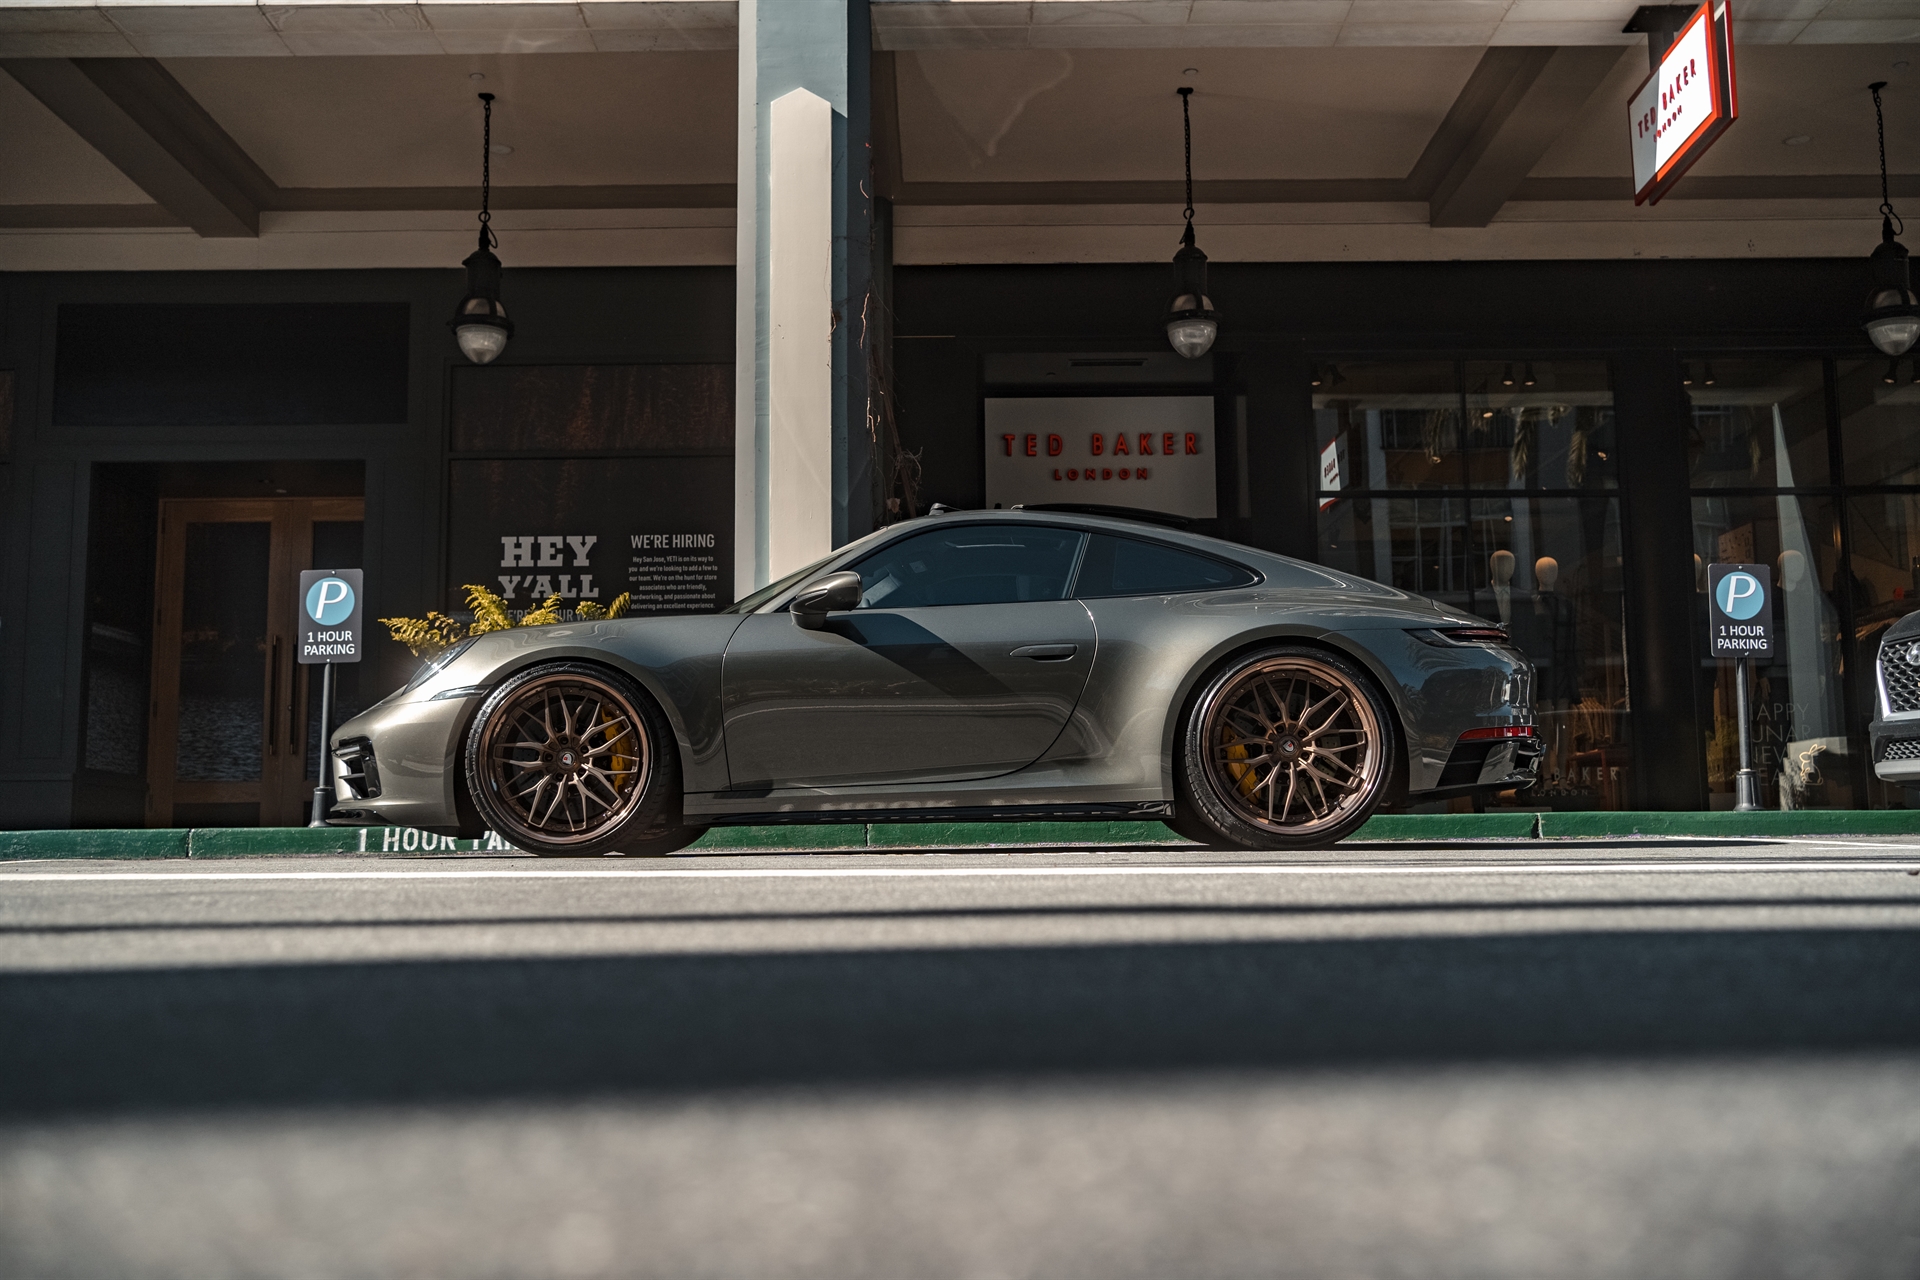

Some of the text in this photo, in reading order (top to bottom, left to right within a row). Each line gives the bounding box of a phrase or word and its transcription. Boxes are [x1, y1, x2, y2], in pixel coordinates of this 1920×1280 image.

[1638, 58, 1696, 138] TED BAKER
[1653, 104, 1682, 143] LONDON
[1003, 432, 1198, 456] TED BAKER
[1054, 468, 1148, 481] LONDON
[630, 533, 715, 548] WE'RE HIRING
[501, 535, 598, 568] HEY
[632, 556, 642, 564] Hey
[498, 574, 600, 598] Y'ALL
[307, 630, 353, 642] 1 HOUR
[1720, 625, 1764, 636] 1 HOUR
[304, 644, 355, 656] PARKING
[1718, 638, 1768, 650] PARKING
[1553, 767, 1618, 781] BAKER
[1531, 788, 1589, 796] LONDON
[359, 828, 368, 852] 1
[382, 828, 456, 852] HOUR
